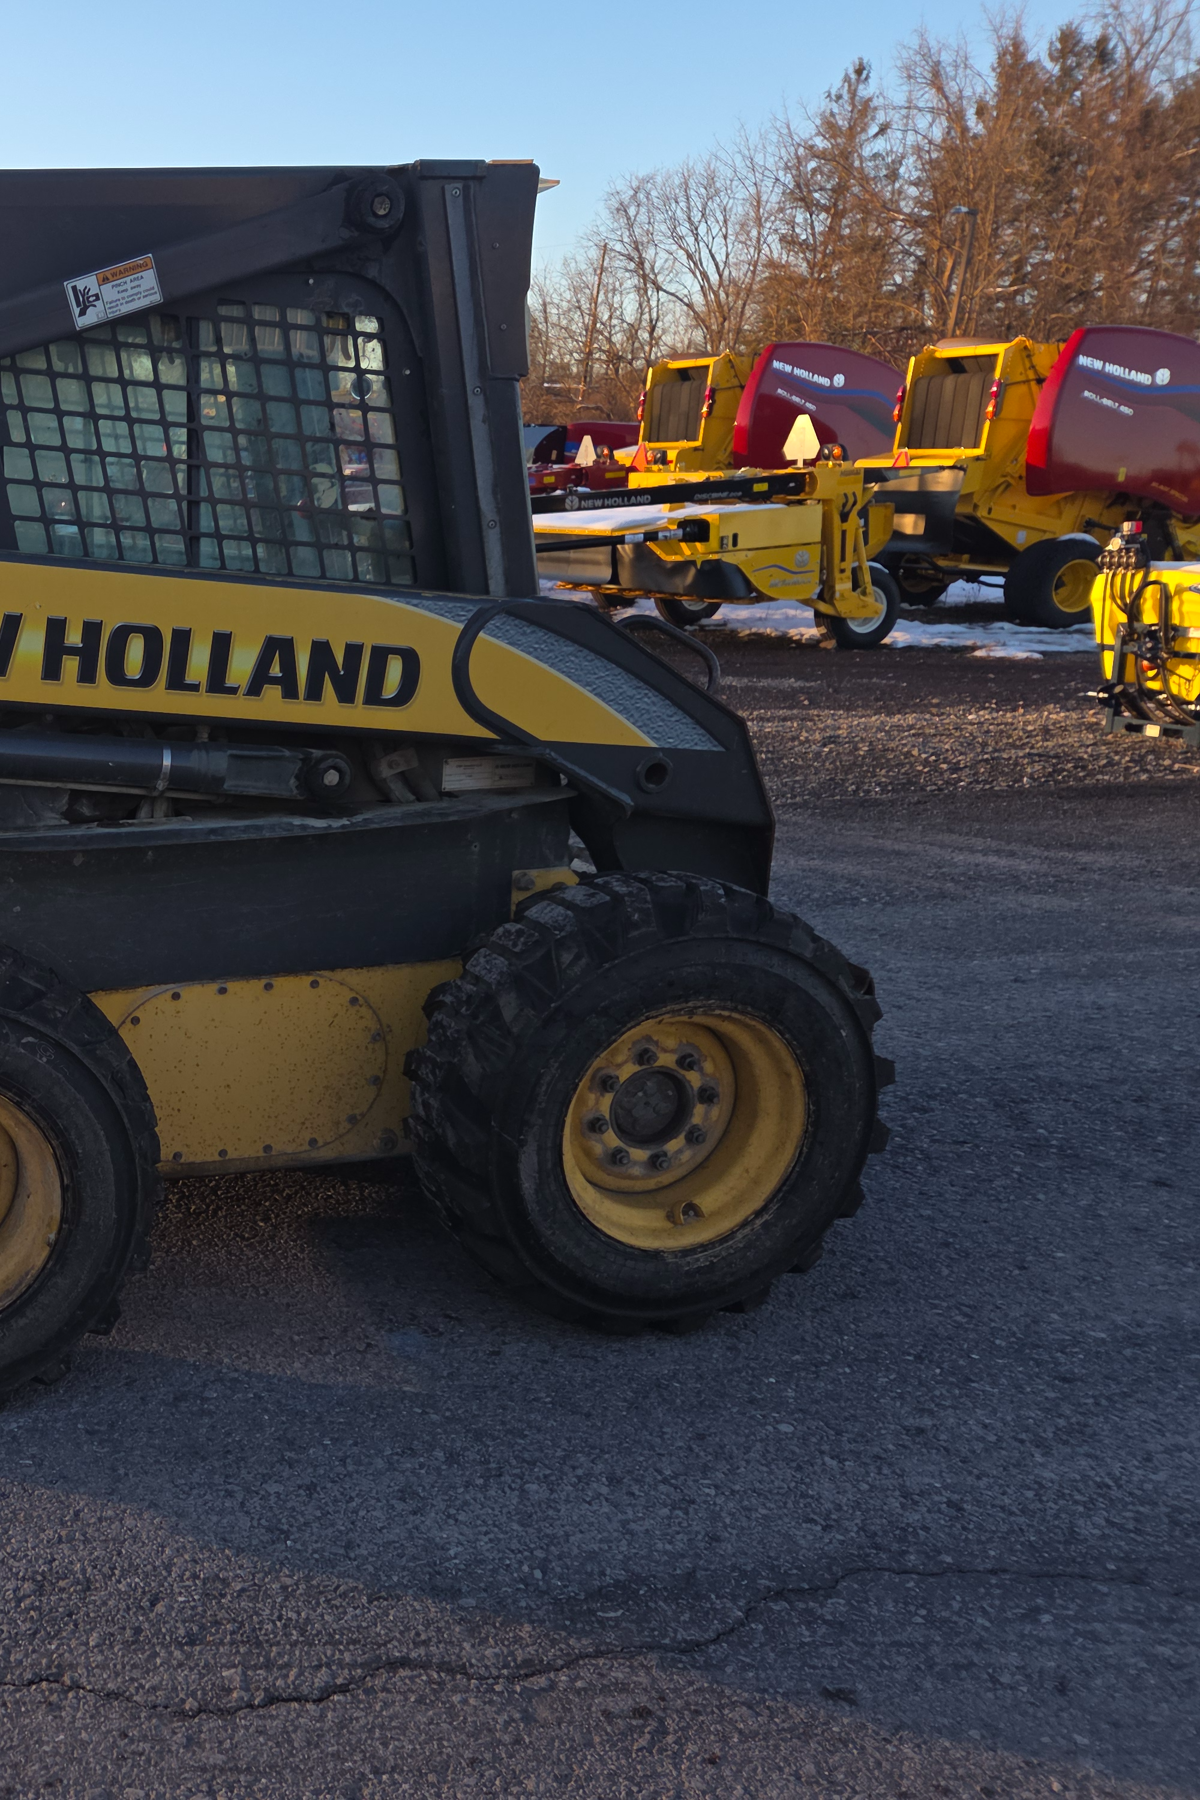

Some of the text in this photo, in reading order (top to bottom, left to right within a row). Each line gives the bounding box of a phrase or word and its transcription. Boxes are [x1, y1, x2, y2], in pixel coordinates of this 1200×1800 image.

[110, 260, 148, 279] WARNING
[111, 275, 145, 290] PINCH AREA
[773, 360, 831, 387] NEW HOLLAND
[1078, 355, 1152, 385] NEW HOLLAND
[581, 495, 651, 508] NEW HOLLAND
[40, 615, 422, 708] HOLLAND
